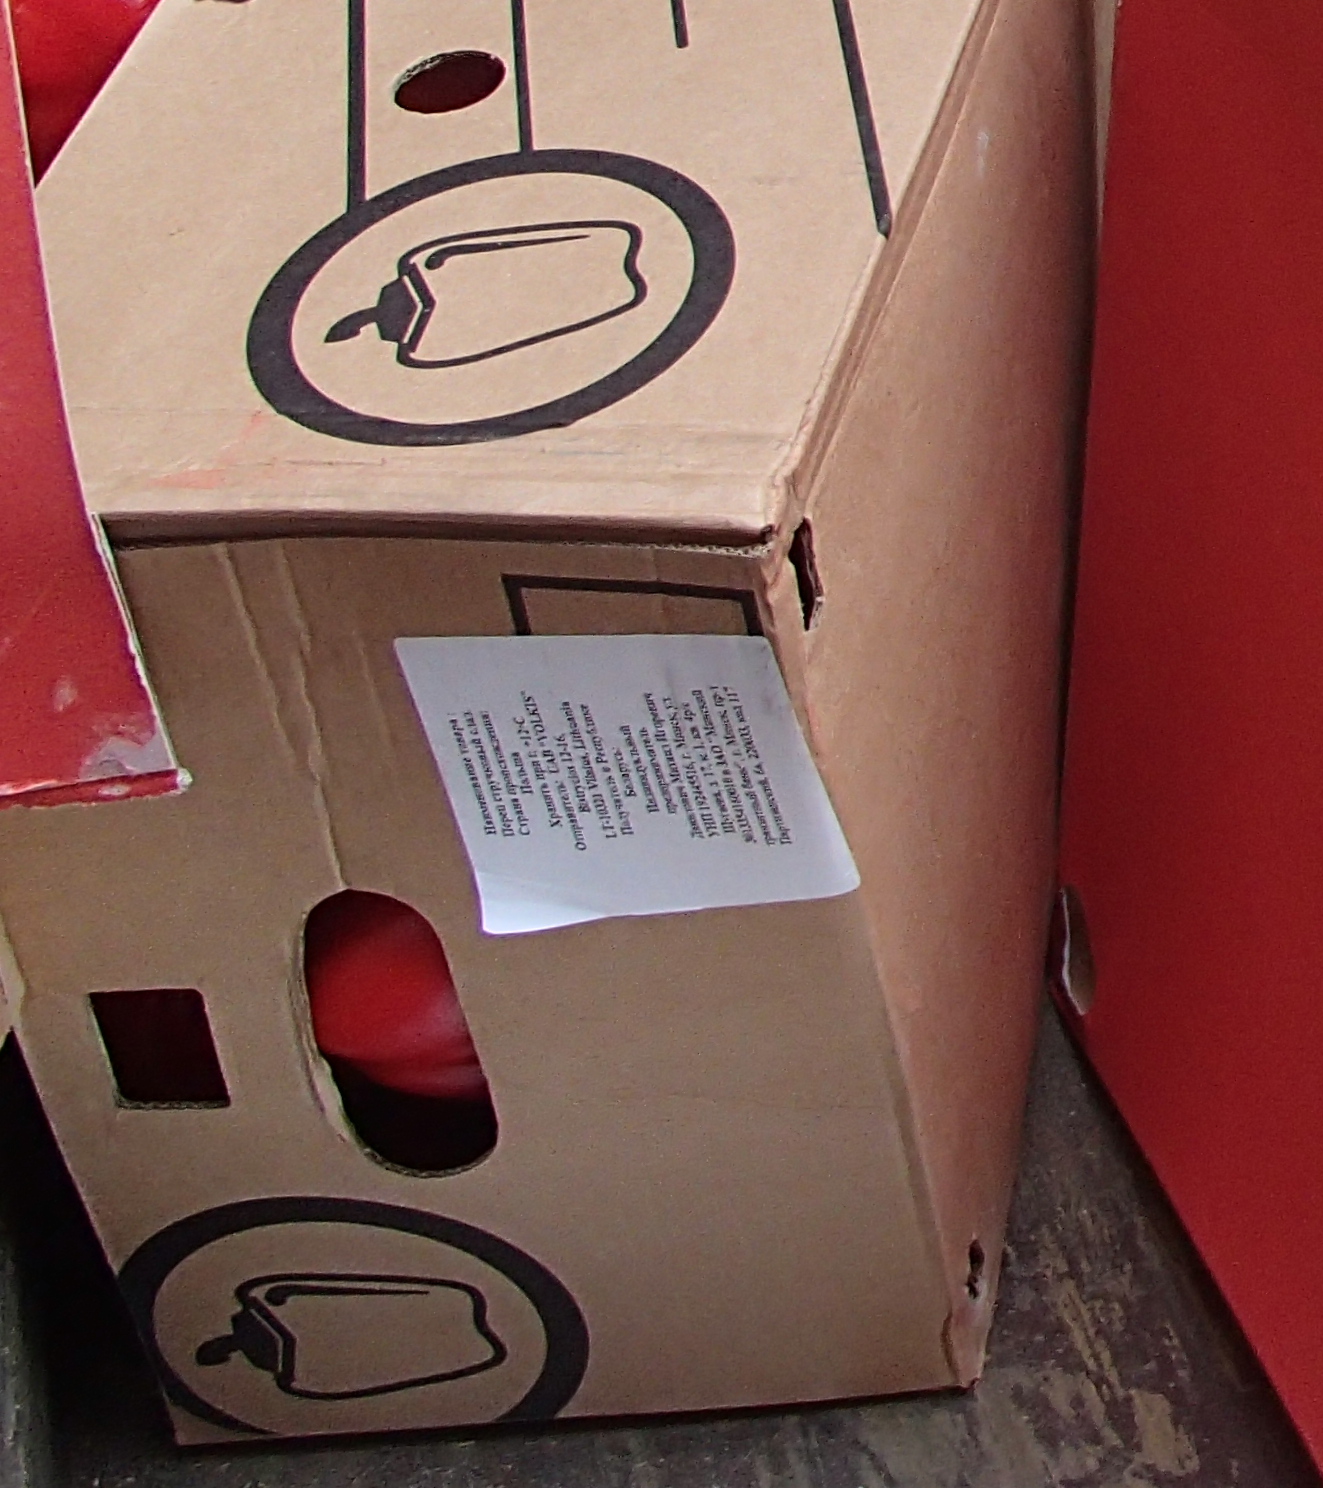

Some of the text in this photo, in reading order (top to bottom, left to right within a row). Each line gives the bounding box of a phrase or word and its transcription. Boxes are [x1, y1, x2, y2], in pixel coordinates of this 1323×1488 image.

[559, 700, 586, 750] Lithuania
[579, 703, 609, 764] Республике
[469, 737, 503, 802] стручковый
[510, 751, 534, 795] Польша
[462, 757, 497, 835] Наименование
[494, 804, 516, 837] Перец
[509, 797, 531, 836] Страна
[538, 782, 563, 828] Хранить
[604, 775, 634, 836] Получатель
